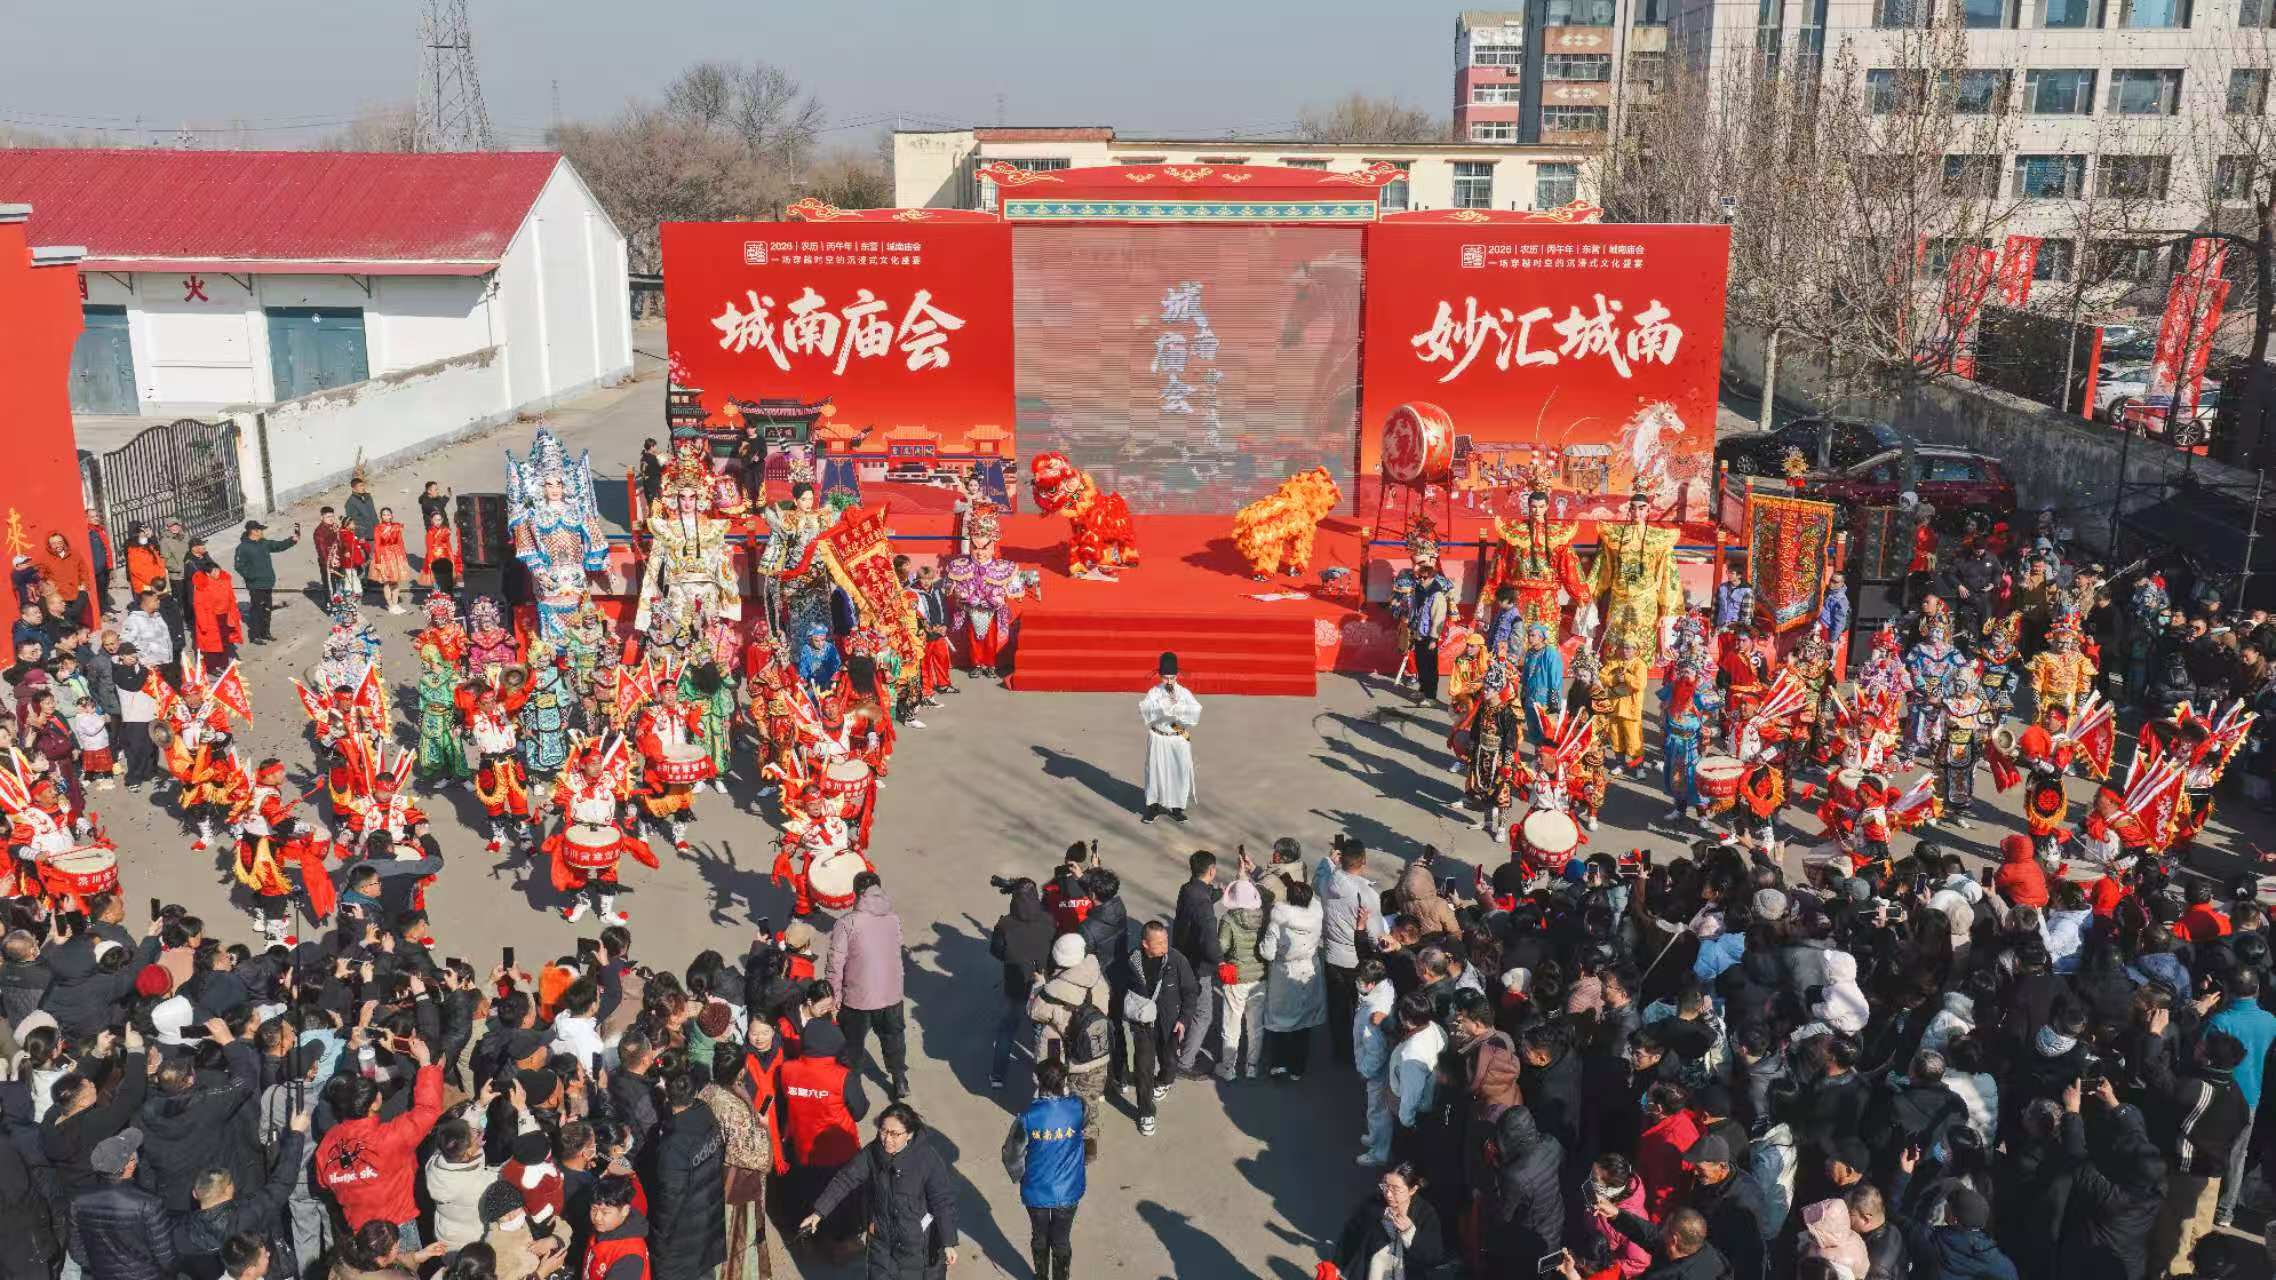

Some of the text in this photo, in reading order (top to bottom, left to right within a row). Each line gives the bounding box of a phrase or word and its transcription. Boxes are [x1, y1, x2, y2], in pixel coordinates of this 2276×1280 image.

[770, 242, 792, 251] 2026
[1488, 245, 1511, 254] 2026
[711, 287, 966, 376] 城南庙会
[1411, 293, 1683, 383] 妙汇城南
